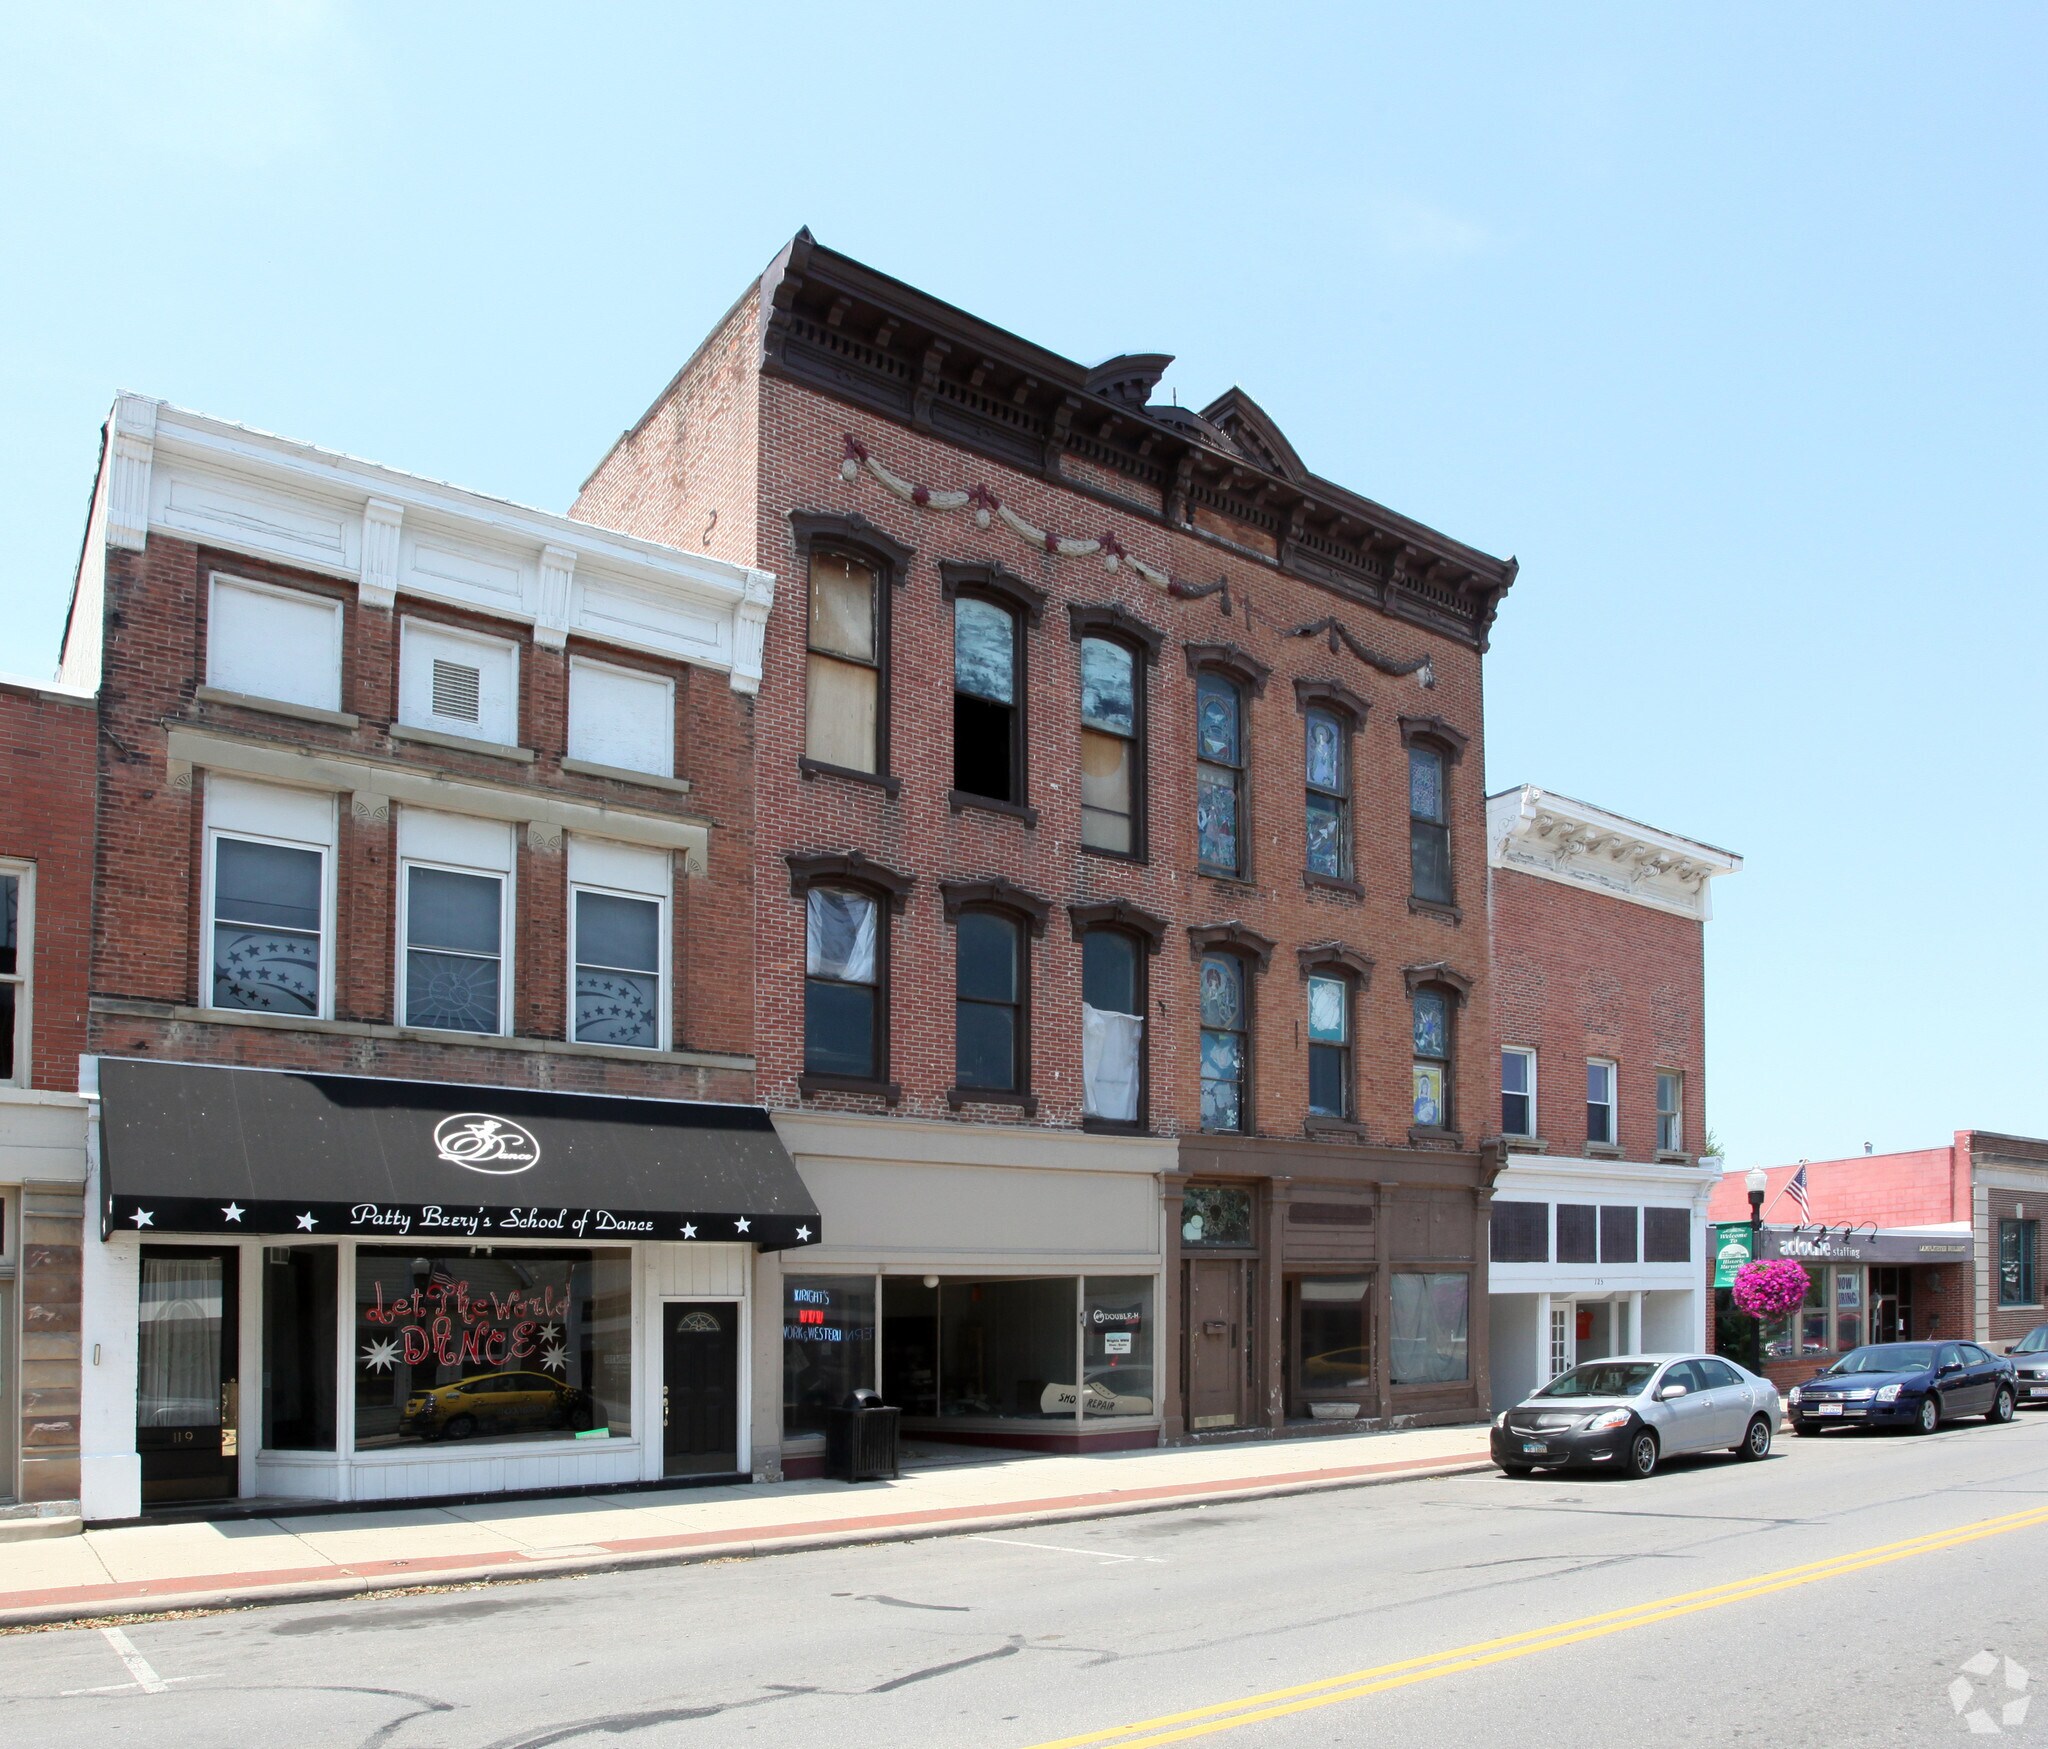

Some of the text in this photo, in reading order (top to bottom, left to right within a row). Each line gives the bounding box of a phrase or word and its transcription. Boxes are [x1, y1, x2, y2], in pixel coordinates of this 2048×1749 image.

[350, 1203, 654, 1237] Patty Beery's School of Dance
[1832, 1247, 1861, 1259] staffing
[365, 1280, 571, 1325] Let The World
[794, 1288, 830, 1305] WRIGHT'S
[1837, 1292, 1858, 1305] IRING
[401, 1315, 537, 1366] DANCE
[1058, 1393, 1116, 1411] SHO REPAIR
[173, 1431, 194, 1444] 119
